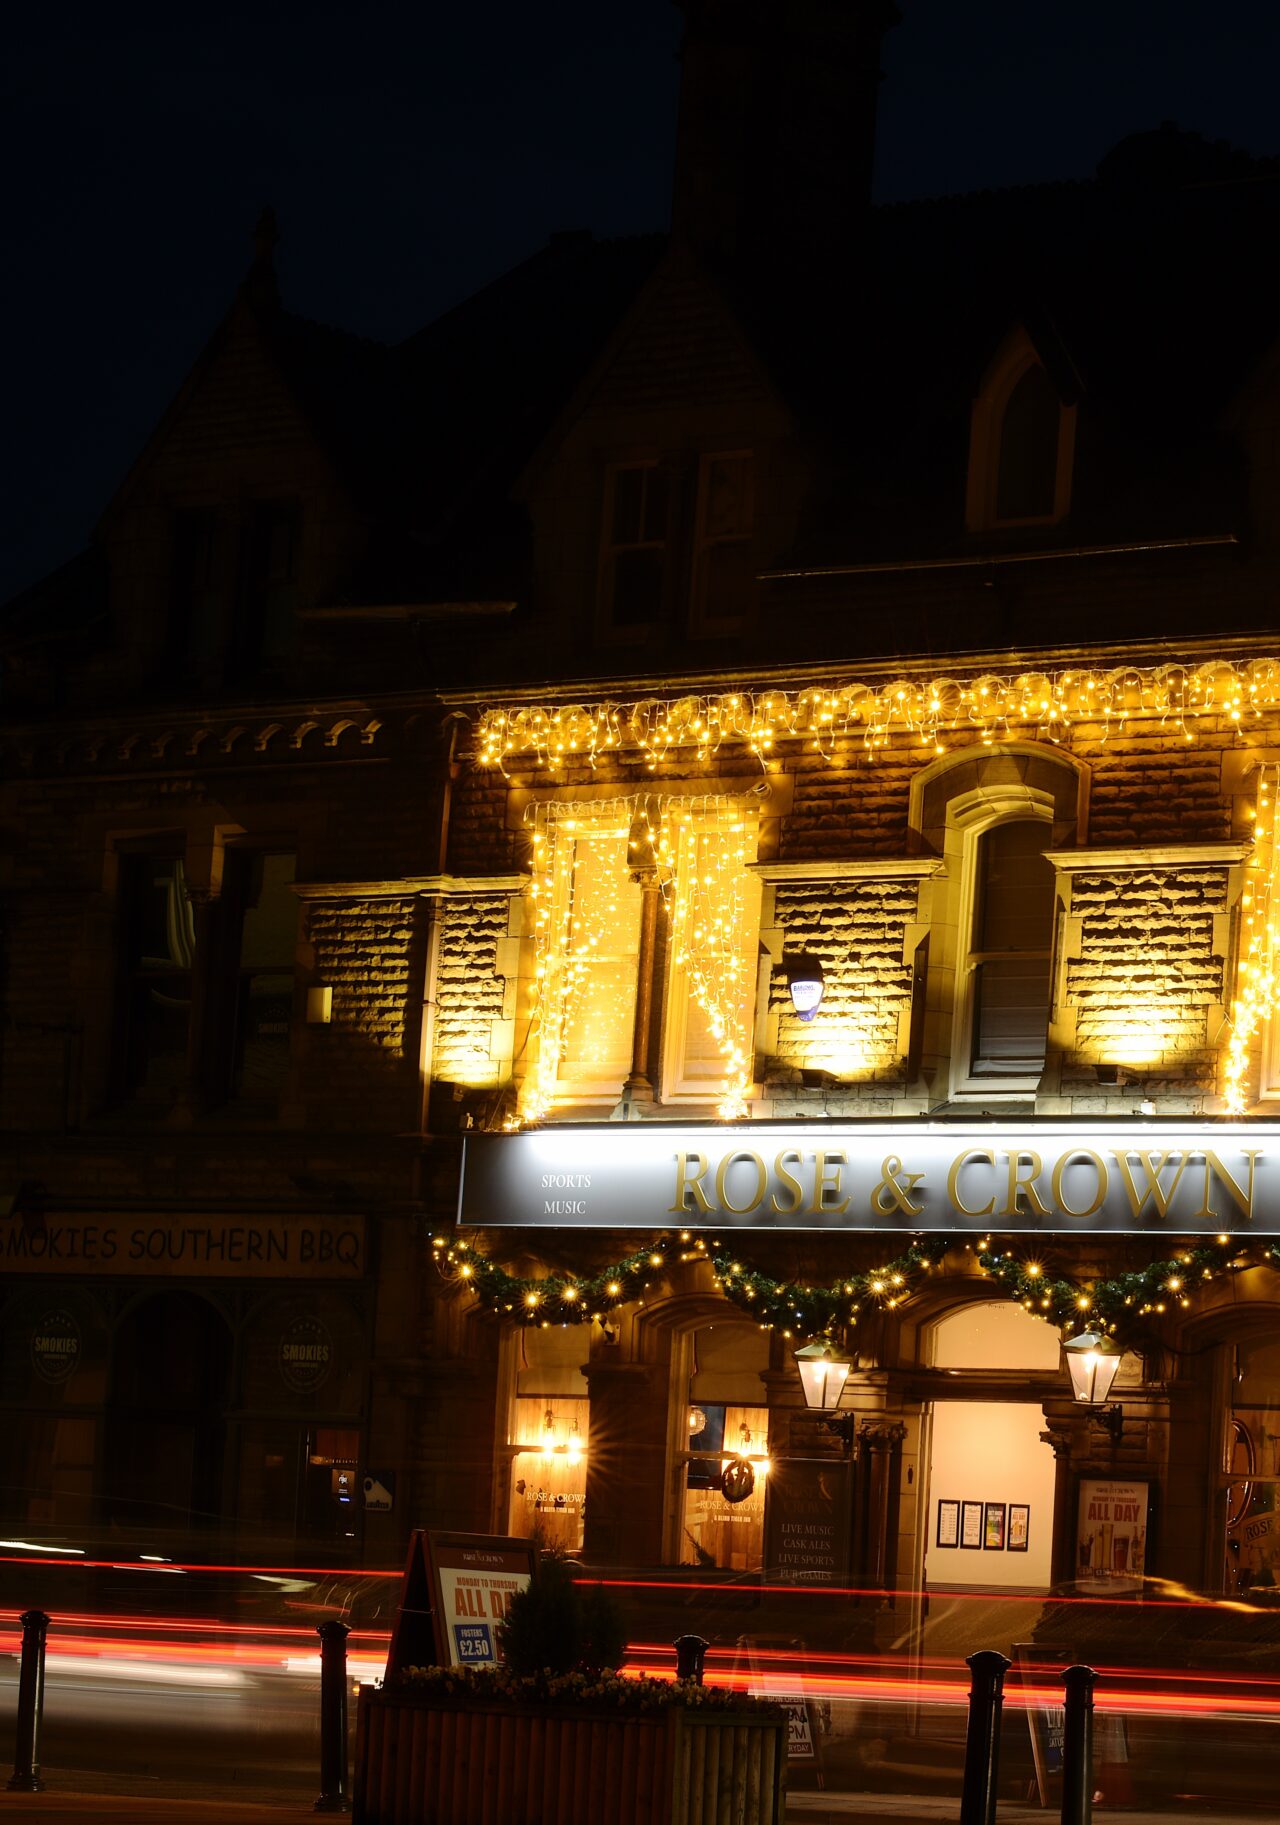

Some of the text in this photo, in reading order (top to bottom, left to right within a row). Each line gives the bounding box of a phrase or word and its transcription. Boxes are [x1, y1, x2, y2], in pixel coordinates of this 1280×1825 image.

[541, 1174, 591, 1188] SPORTS
[667, 1147, 1264, 1218] ROSE & CROWN
[543, 1200, 586, 1214] MUSIC
[0, 1226, 360, 1269] MOKIES SOUTHERN BBQ
[35, 1336, 77, 1353] SMOKIES
[283, 1344, 329, 1361] SMOKIES
[527, 1492, 548, 1501] ROSE
[700, 1501, 721, 1510] ROSE
[1088, 1503, 1140, 1522] ALL DAY
[781, 1523, 835, 1536] LIVE MUSIC
[1246, 1519, 1273, 1540] ROSE
[783, 1538, 832, 1551] CASK ALES
[778, 1553, 835, 1565] LIVE SPORTS
[800, 1570, 832, 1581] GAMES
[456, 1576, 518, 1590] MONDAY TO THURSDAY
[455, 1587, 513, 1619] ALL DA
[460, 1628, 484, 1639] FOSTERS
[460, 1639, 490, 1656] £2.50
[788, 1724, 807, 1740] PM
[788, 1743, 809, 1753] RYDAY
